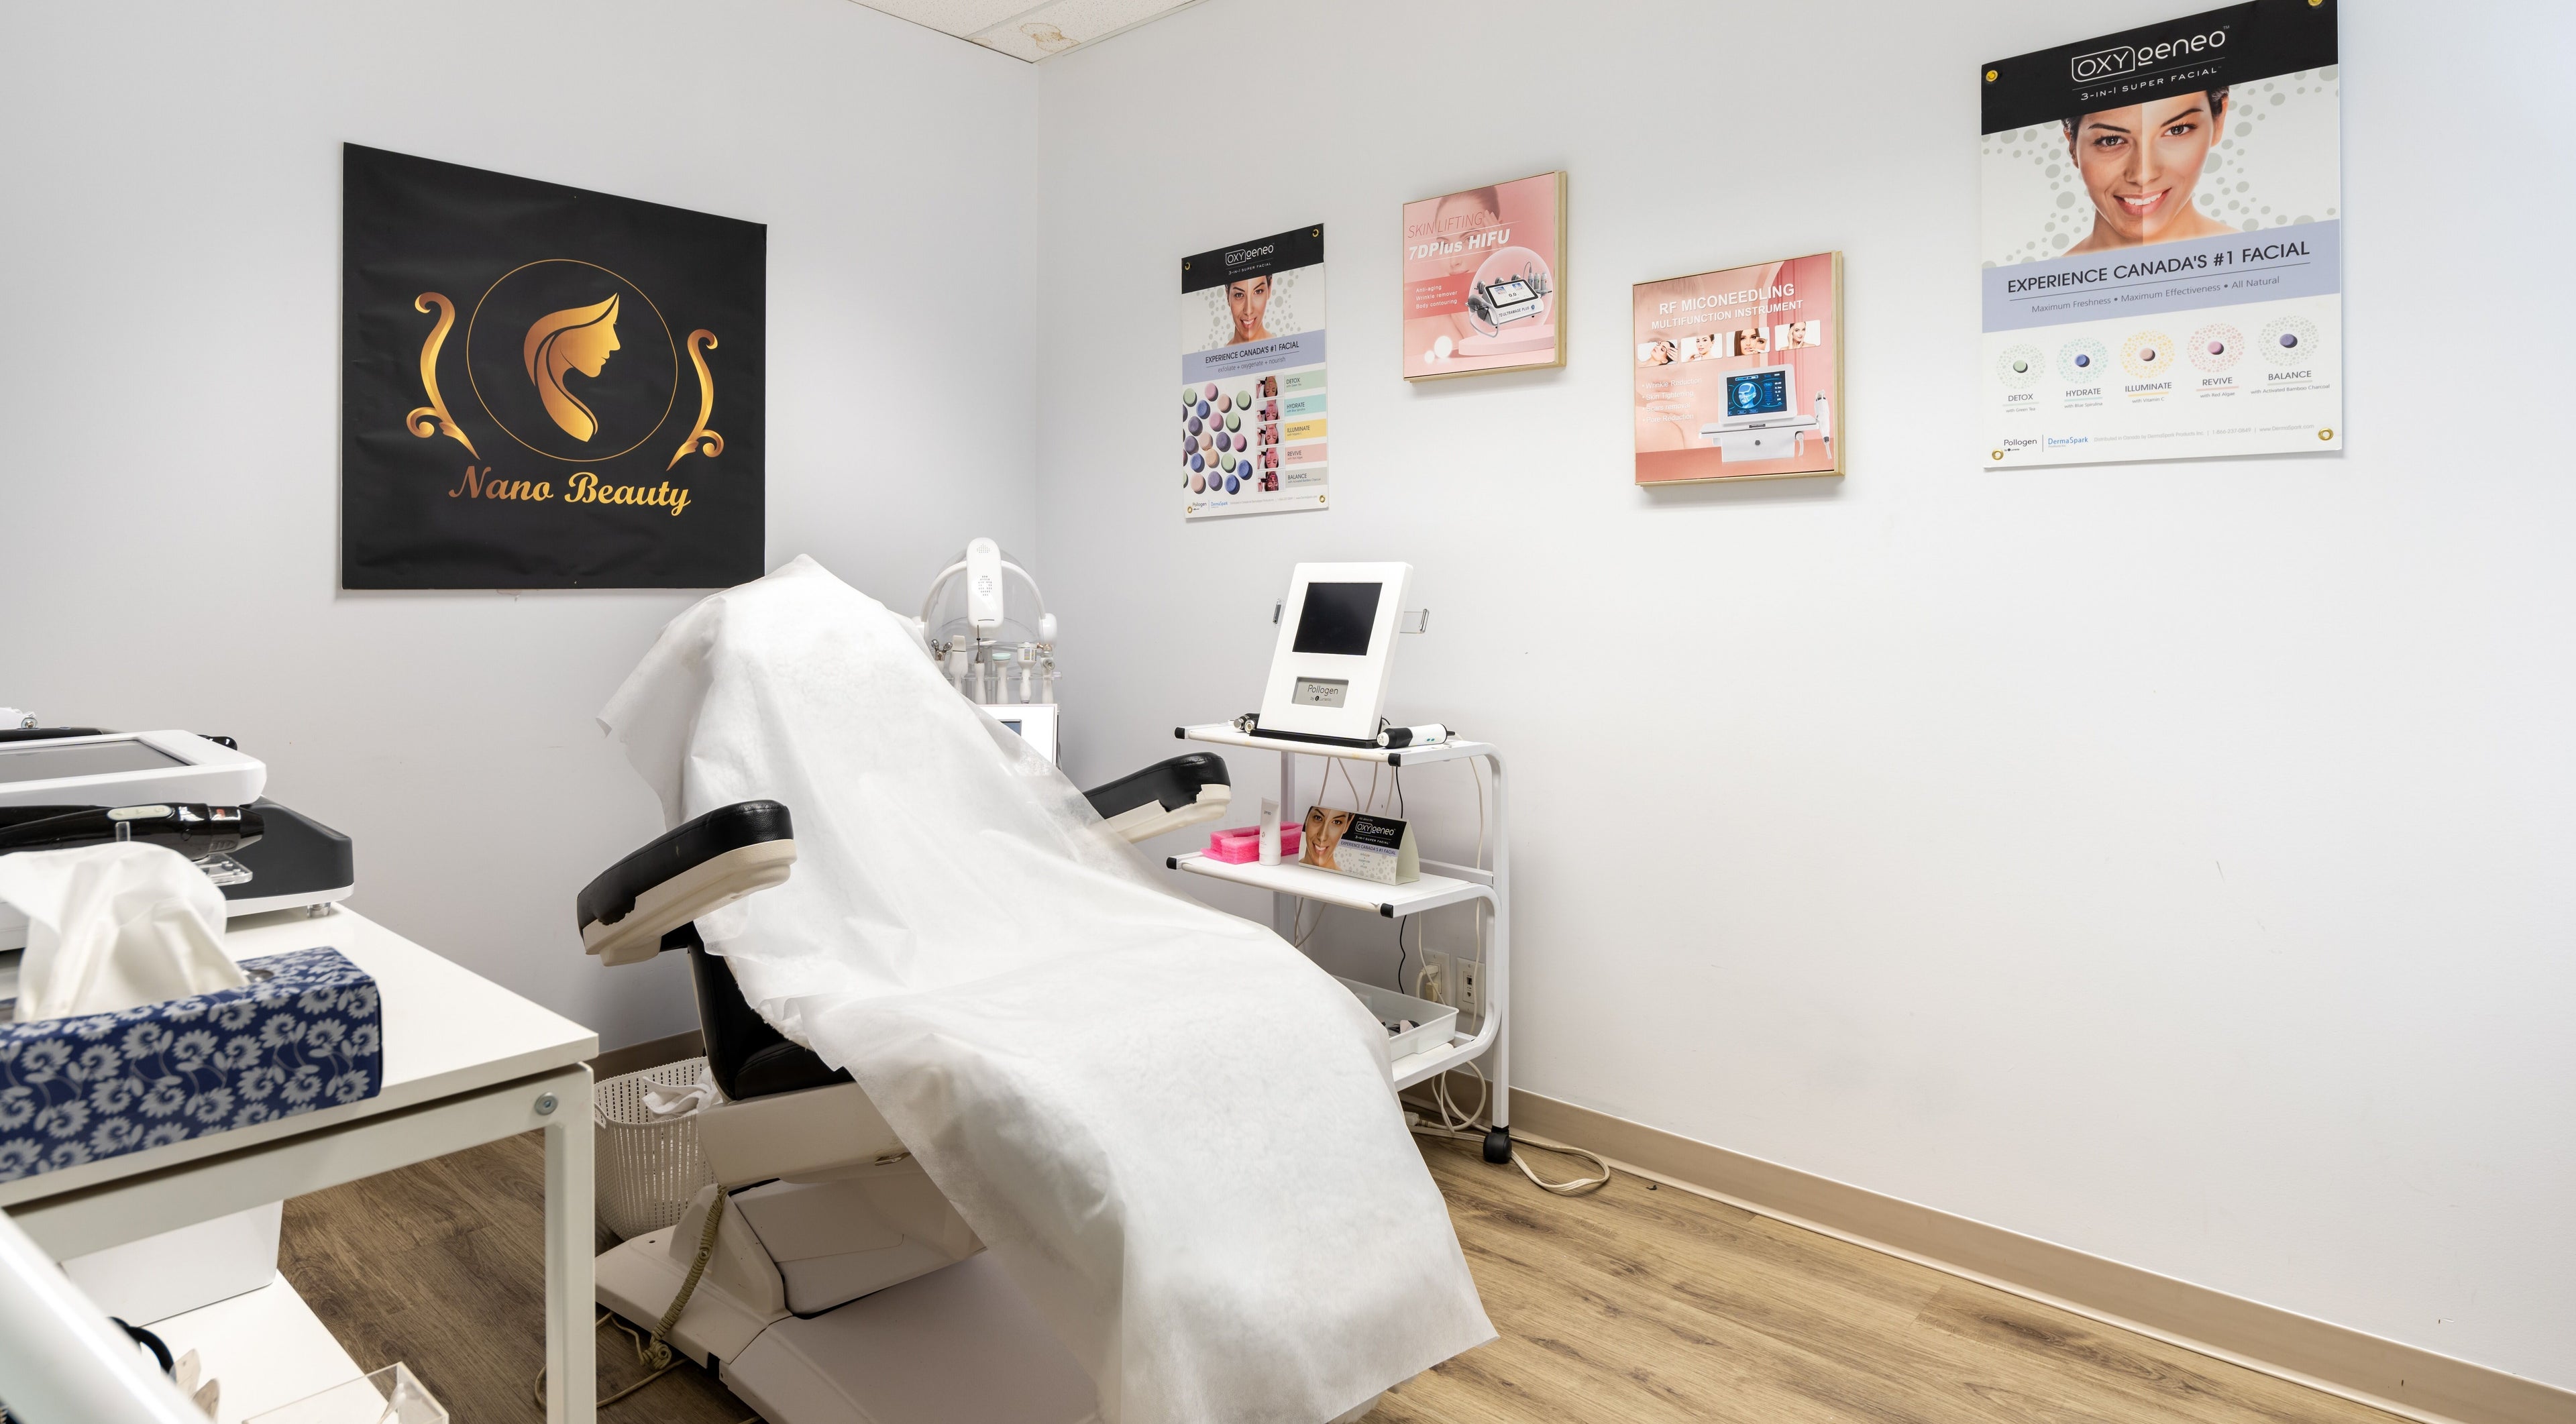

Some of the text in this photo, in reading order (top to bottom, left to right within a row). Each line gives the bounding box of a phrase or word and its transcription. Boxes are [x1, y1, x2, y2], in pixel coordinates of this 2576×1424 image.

[2122, 78, 2164, 92] SUPER
[2171, 67, 2216, 82] FACIAL
[1407, 212, 1483, 238] SKIN LIFTING
[1409, 229, 1510, 260] 7DPlus HIFU
[2008, 241, 2310, 293] EXPERIENCE CANADA'S #1 FACIAL
[1416, 285, 1442, 293] Anti-aging
[2032, 276, 2279, 313] Maximum Freshness Maximum Effectiveness All Natural
[1660, 283, 1794, 315] RF MICONEEDLING
[1652, 300, 1803, 329] MULTIFUNCTION INSTRUMENT
[1205, 351, 1238, 364] EXPERIENCE
[1240, 346, 1269, 358] CANADA'S
[1279, 341, 1299, 351] FACIAL
[1218, 365, 1236, 373] exfoliate
[1241, 361, 1263, 370] oxygenate
[1269, 356, 1286, 364] nourish
[1670, 378, 1701, 386] Reduction
[2202, 377, 2233, 386] REVIVE
[2268, 370, 2312, 380] BALANCE
[2065, 388, 2101, 397] HYDRATE
[2125, 382, 2171, 392] ILLUMINATE
[1662, 390, 1694, 399] Tightening
[2008, 394, 2033, 402] DETOX
[2048, 437, 2088, 445] DermaSpark
[449, 465, 691, 516] Nano Beauty
[1307, 684, 1338, 696] Pollogen
